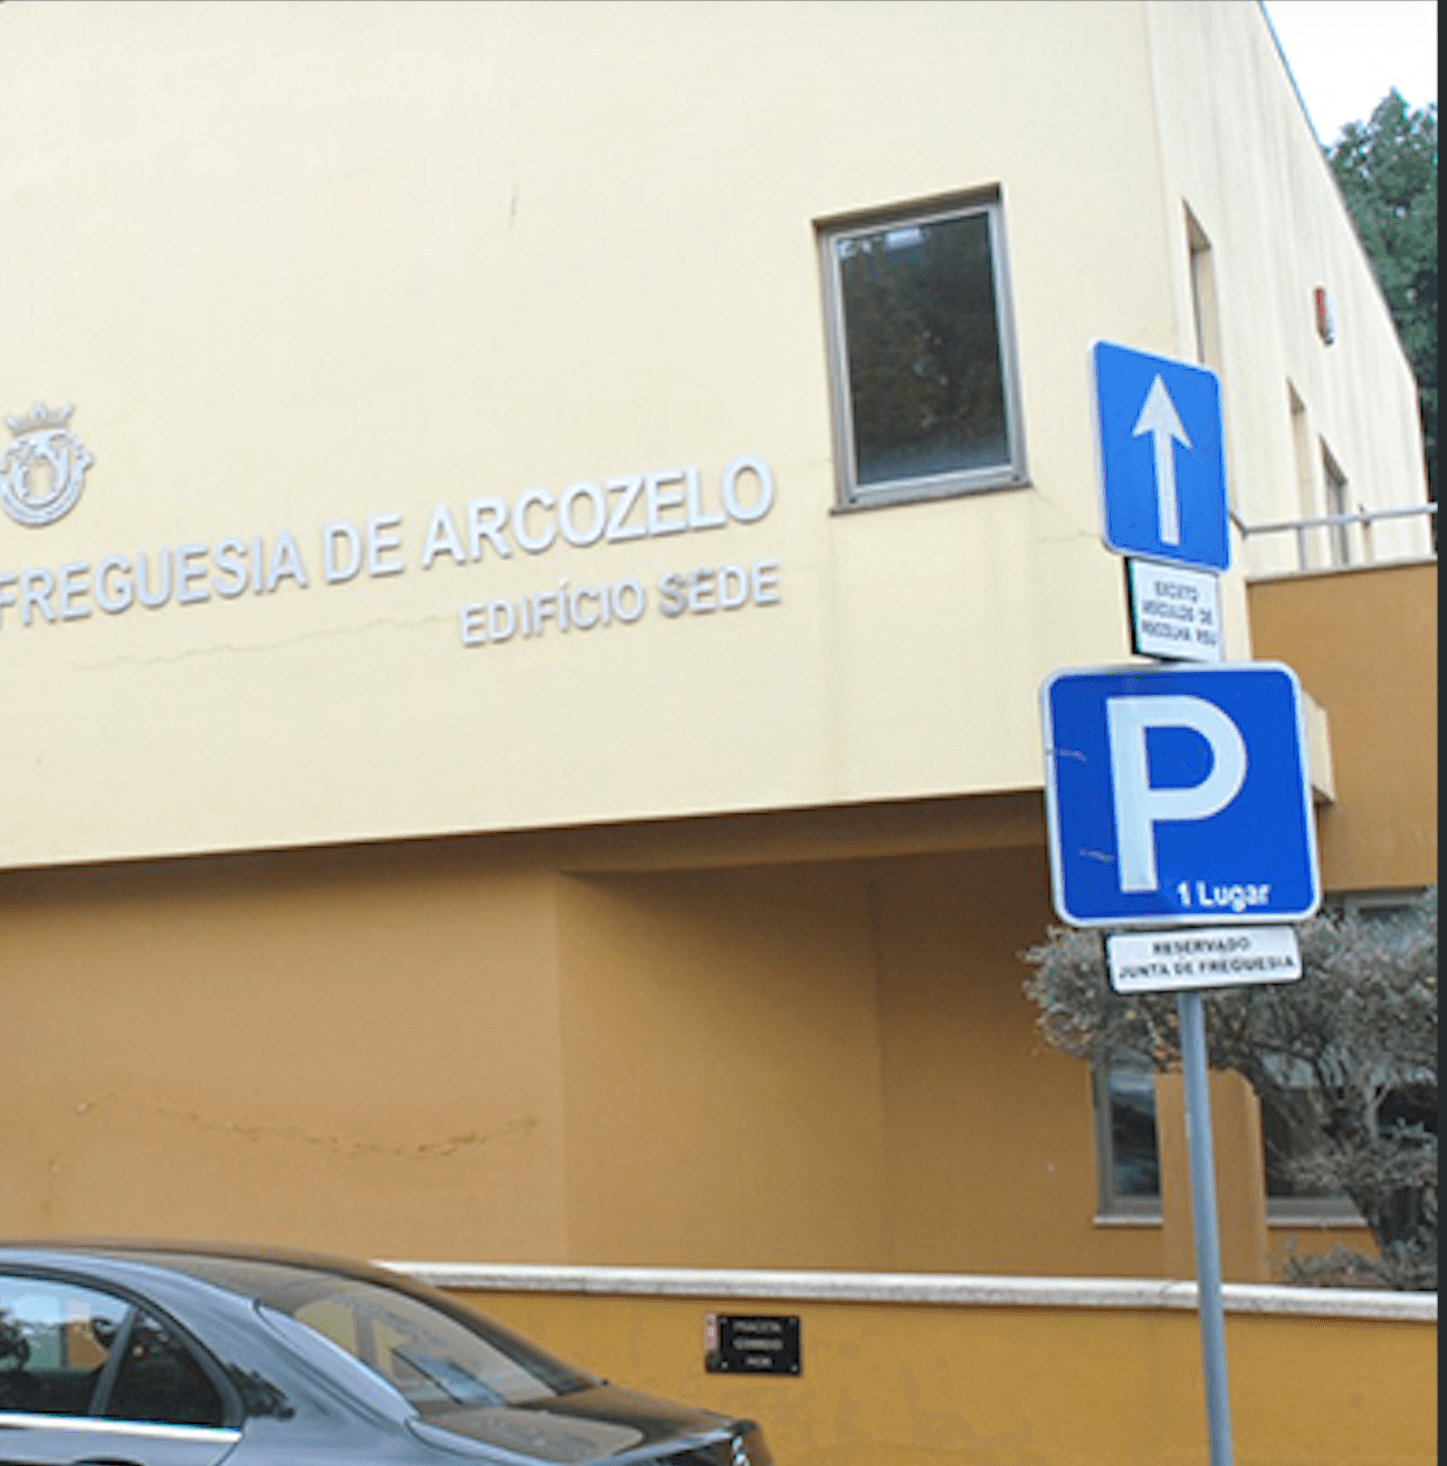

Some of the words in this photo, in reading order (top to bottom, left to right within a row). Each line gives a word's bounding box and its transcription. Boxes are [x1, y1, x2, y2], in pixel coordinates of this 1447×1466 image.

[323, 512, 405, 586] DE
[421, 455, 775, 570] ARCOZELO
[460, 576, 645, 647] EDIFÍCIO
[658, 559, 782, 619] SEDE
[1105, 694, 1248, 894] P
[1176, 880, 1191, 908] 1
[1195, 880, 1271, 913] Lugar
[1118, 963, 1170, 979] JUNTA
[1173, 960, 1194, 976] DE
[1198, 954, 1295, 974] FREGUESIA
[1153, 936, 1252, 956] RESERVADO
